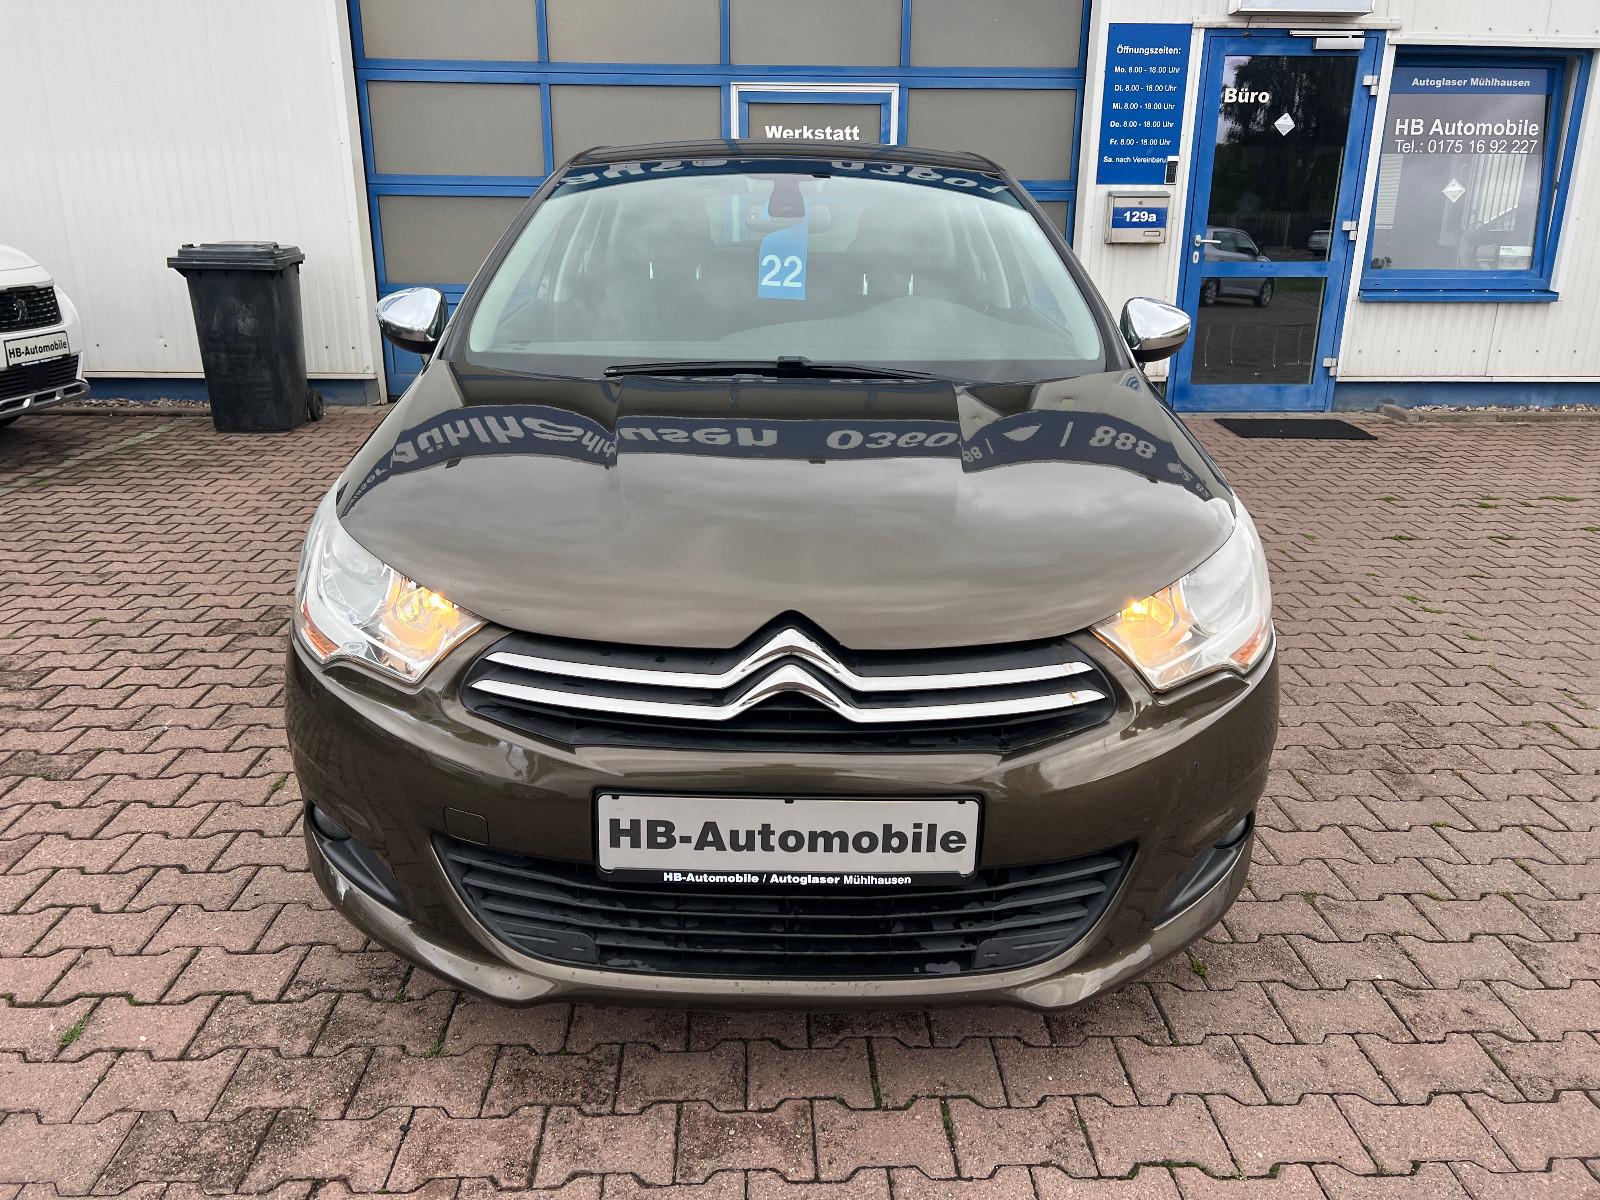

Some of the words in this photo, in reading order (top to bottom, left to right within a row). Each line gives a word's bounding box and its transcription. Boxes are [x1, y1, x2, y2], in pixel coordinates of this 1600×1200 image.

[1116, 44, 1182, 56] Öffnungszeiten:
[1412, 77, 1467, 87] Autoglaser
[1470, 77, 1531, 87] Mühlhausen
[1224, 87, 1270, 103] Büro
[1112, 102, 1122, 110] Mi.
[1123, 102, 1138, 110] 8.00
[1163, 102, 1175, 110] Uhr
[764, 125, 860, 141] Werkstatt
[1395, 118, 1424, 136] HB
[1429, 118, 1539, 136] Automobile
[1109, 138, 1118, 146] Fr.
[1120, 138, 1135, 146] 8.00
[1159, 138, 1171, 146] Uhr
[1395, 139, 1423, 153] Tel.:
[1428, 139, 1463, 153] 0175
[1469, 139, 1485, 153] 16
[1489, 139, 1507, 154] 92
[1511, 139, 1538, 154] 227
[1103, 155, 1114, 163] Sa.
[1115, 155, 1131, 163] nach
[1123, 211, 1157, 222] 129a
[760, 254, 803, 288] 22
[8, 340, 67, 359] HB-Automobile
[608, 817, 967, 854] HB-Automobile
[663, 871, 759, 885] HB-Automobile
[770, 873, 840, 887] Autoglaser
[843, 873, 912, 886] Mühlhausen
